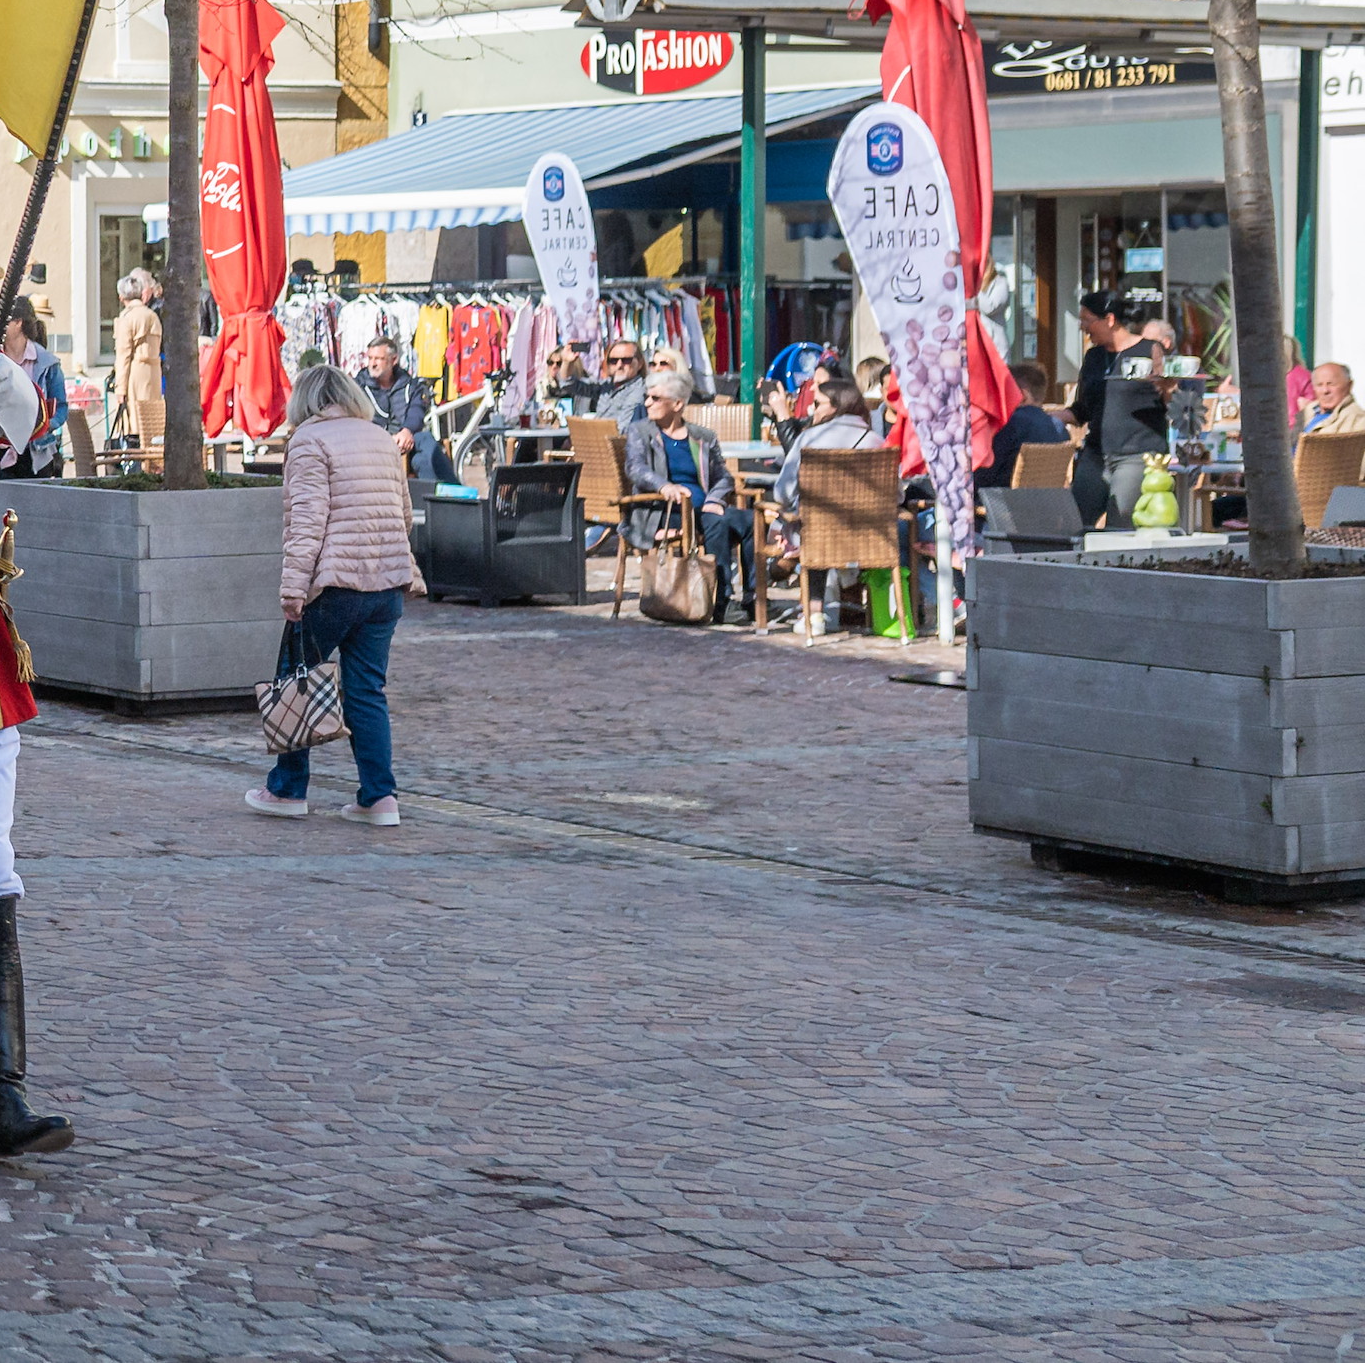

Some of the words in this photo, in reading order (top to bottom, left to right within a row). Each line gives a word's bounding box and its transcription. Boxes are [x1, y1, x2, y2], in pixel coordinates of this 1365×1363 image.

[1045, 71, 1080, 91] 0681
[1094, 68, 1111, 88] 81
[1117, 66, 1144, 86] 233
[1149, 64, 1175, 84] 791
